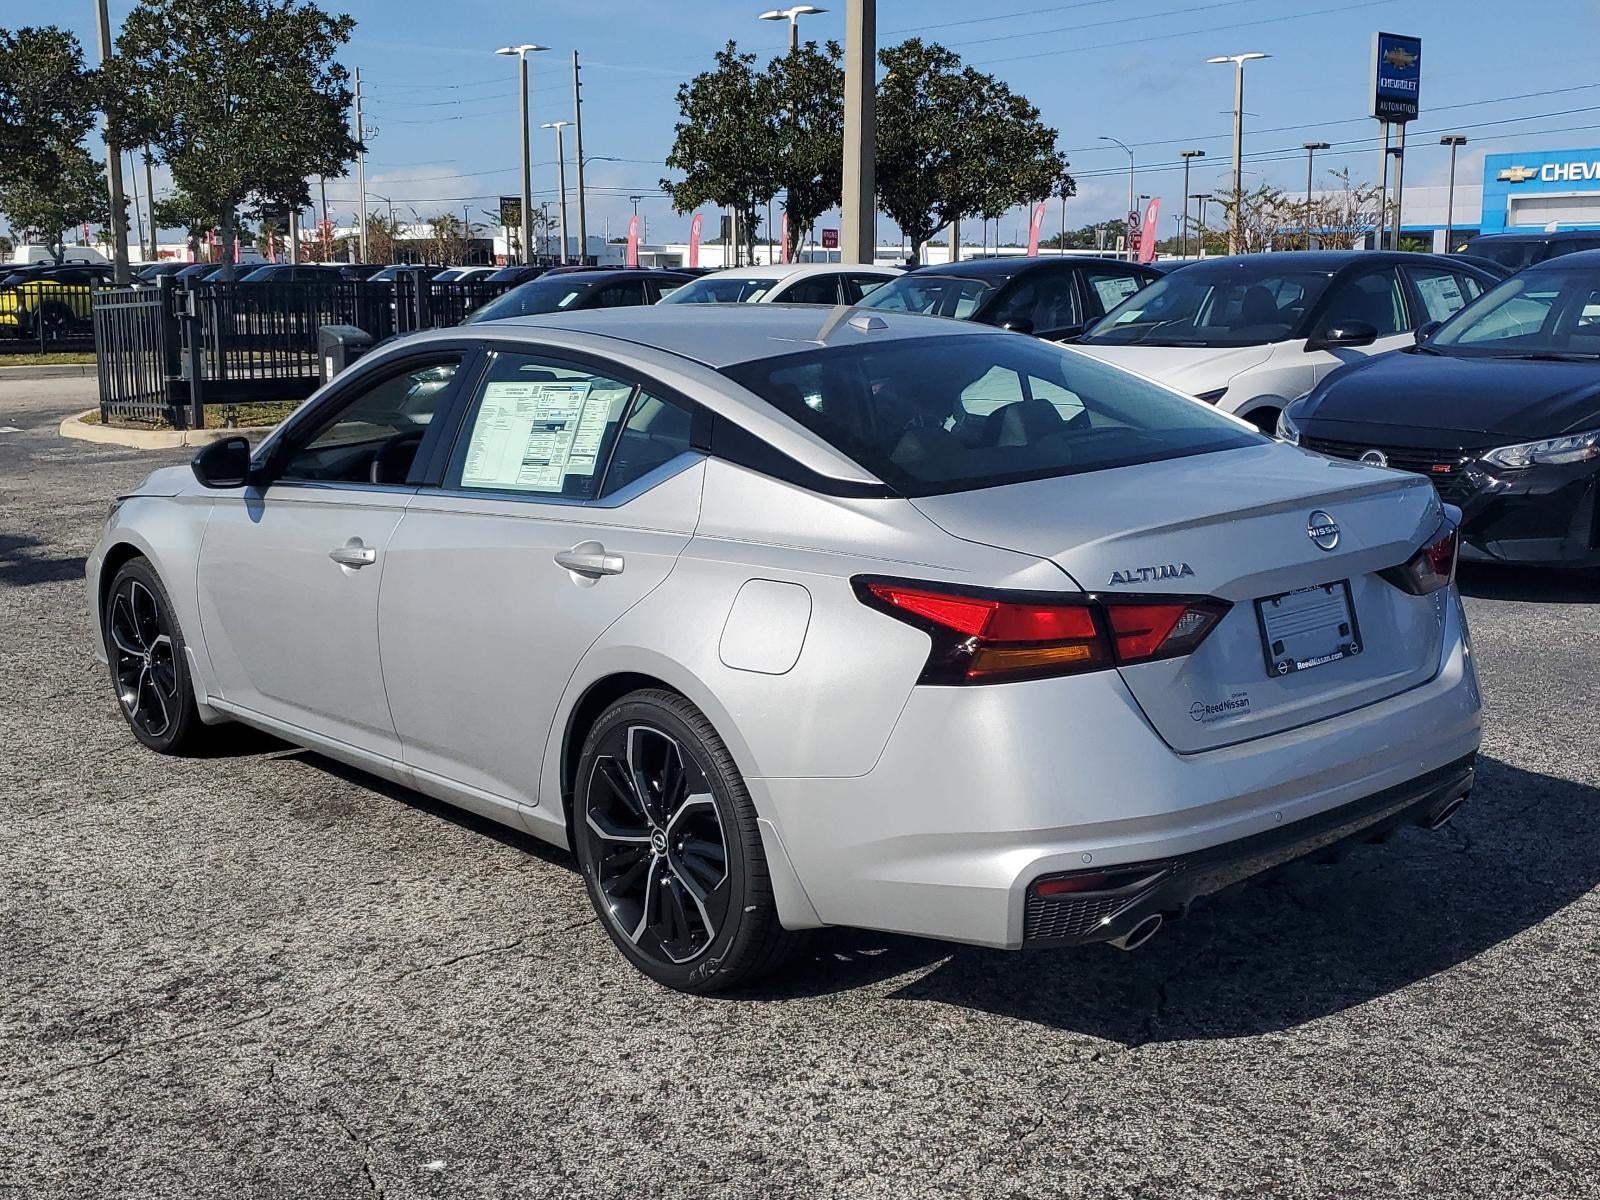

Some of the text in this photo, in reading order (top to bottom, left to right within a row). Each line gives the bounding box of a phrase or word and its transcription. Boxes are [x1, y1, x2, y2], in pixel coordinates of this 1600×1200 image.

[1380, 77, 1417, 91] CHEVROLET
[1379, 101, 1416, 113] AUTONATION
[1541, 161, 1600, 182] CHEV
[1308, 524, 1340, 537] NISSAN
[1107, 562, 1195, 586] ALTIMA
[1296, 652, 1344, 670] ReedNissan.com
